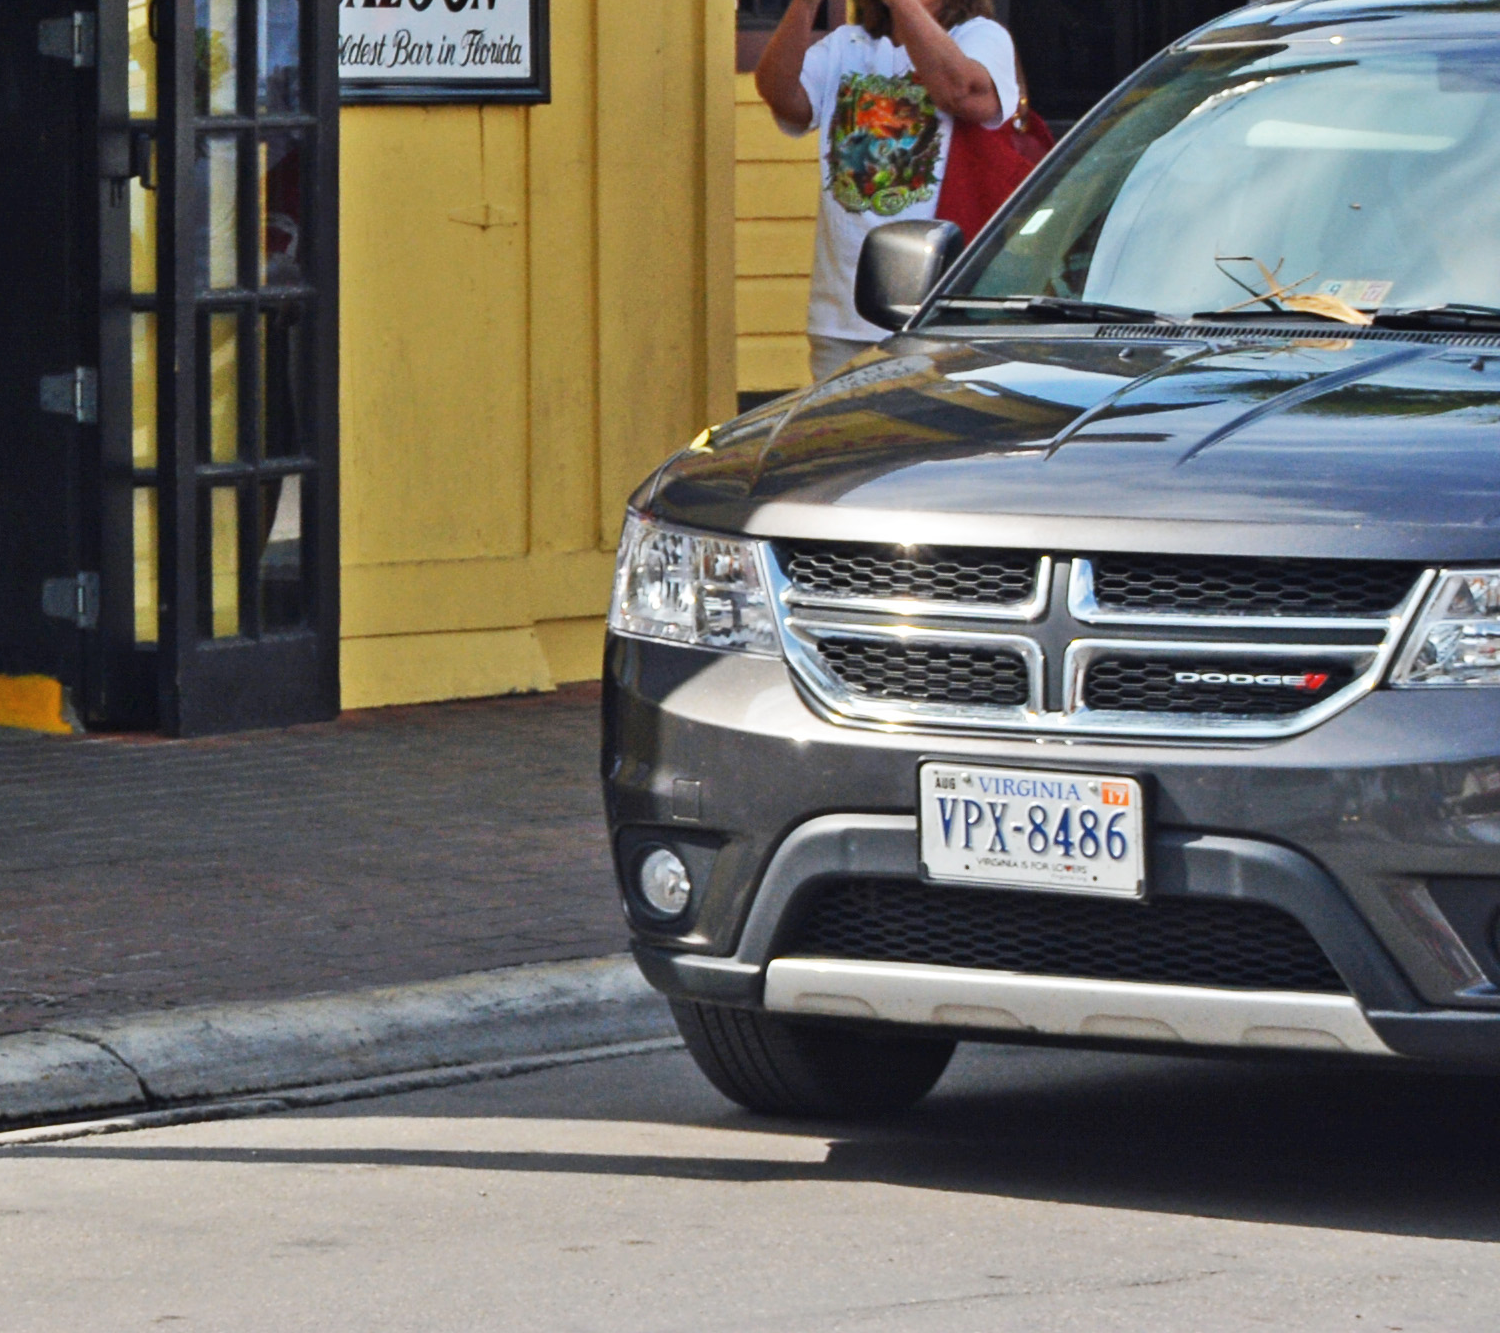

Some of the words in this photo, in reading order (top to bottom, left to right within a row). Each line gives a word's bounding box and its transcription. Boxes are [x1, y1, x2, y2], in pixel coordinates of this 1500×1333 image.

[339, 33, 387, 66] ldest
[386, 28, 432, 68] Bar
[437, 34, 457, 66] in
[459, 28, 524, 68] Florida
[1174, 671, 1307, 686] DODGE
[934, 776, 957, 791] AUG
[978, 775, 1083, 802] VIRGINIA
[935, 795, 1129, 861] VPX-8486
[975, 856, 1019, 869] VIRGINIA
[1030, 861, 1050, 871] FOR
